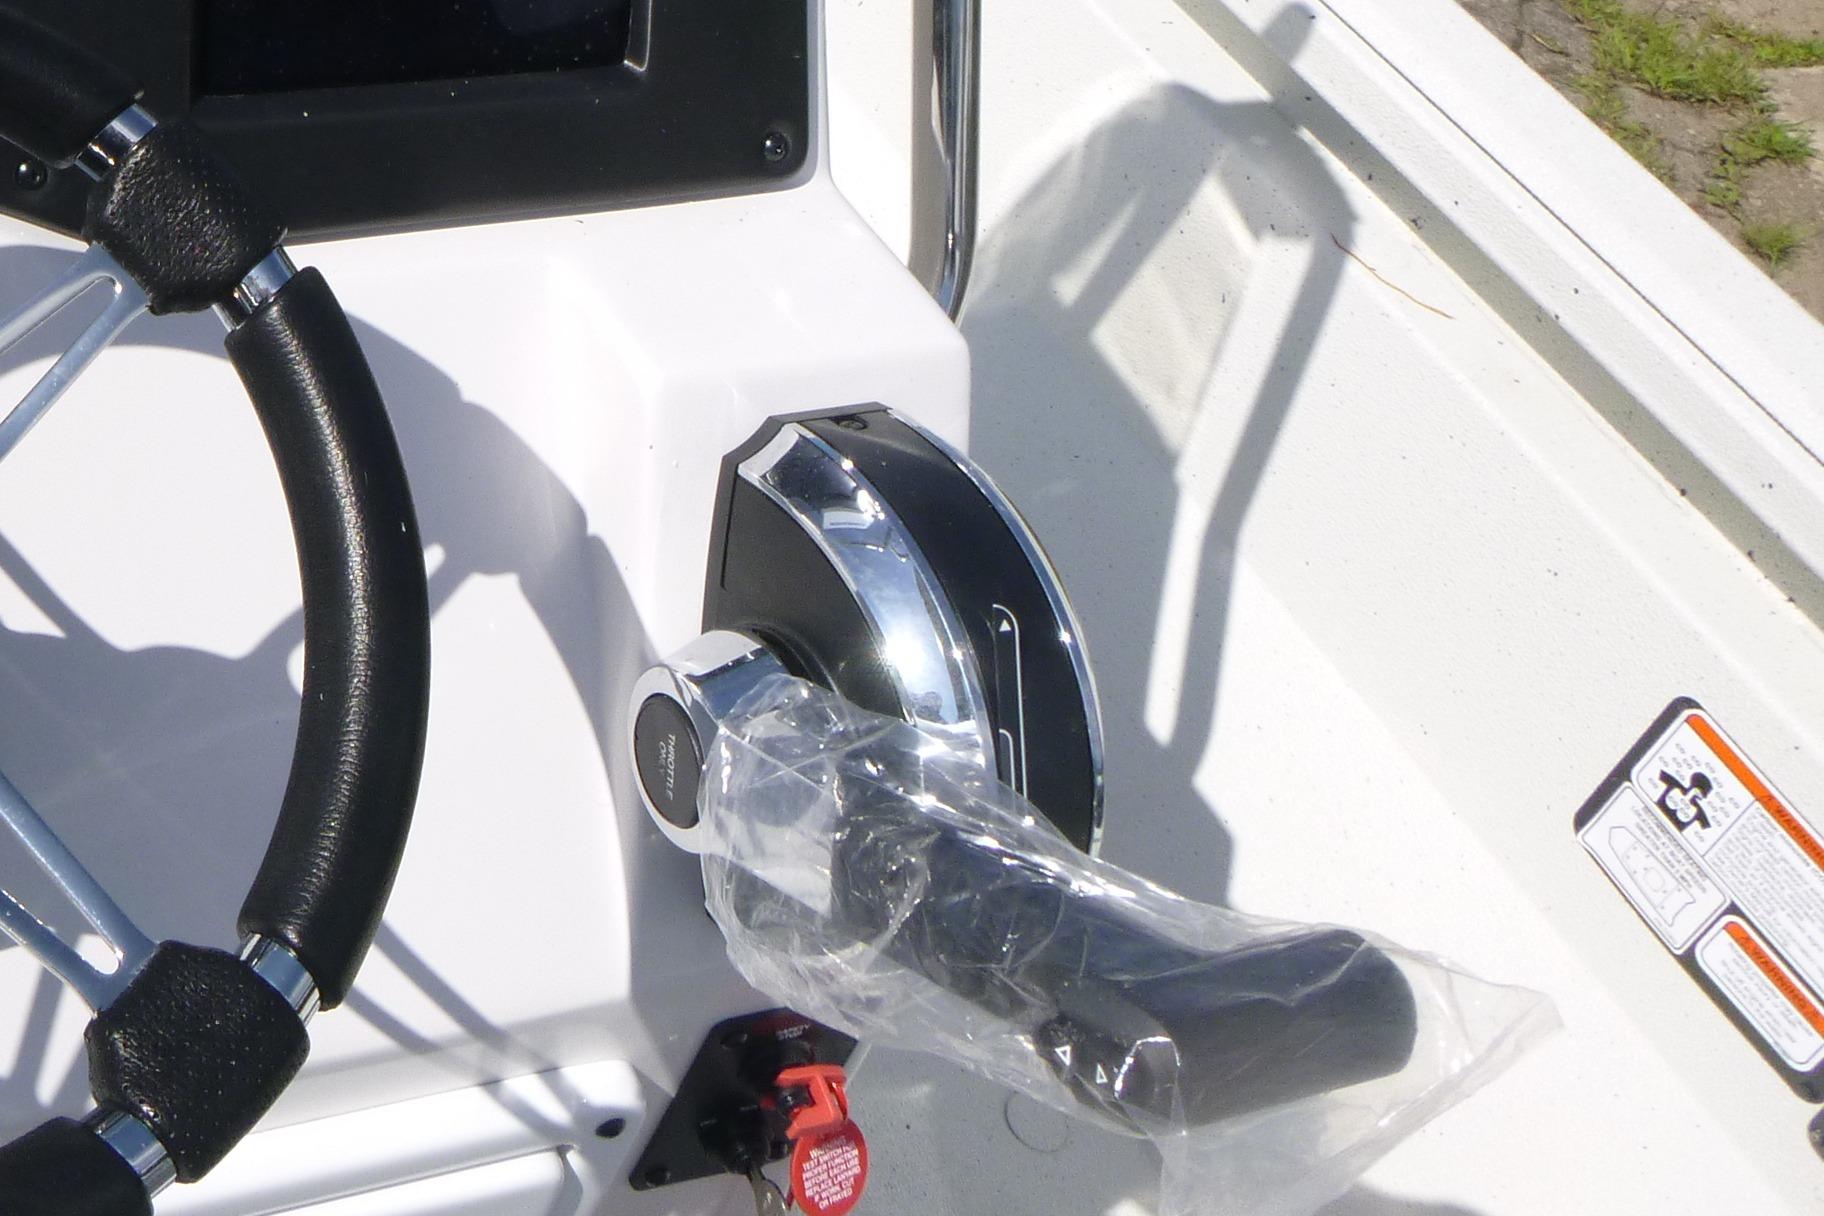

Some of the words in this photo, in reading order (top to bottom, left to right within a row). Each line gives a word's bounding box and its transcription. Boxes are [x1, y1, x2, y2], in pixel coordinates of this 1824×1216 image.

[801, 1157, 818, 1171] TEST
[818, 1146, 843, 1164] SWITCH
[801, 1162, 827, 1181] PROPER
[827, 1148, 859, 1169] FUNCTION
[803, 1172, 829, 1188] BEFORE
[828, 1162, 847, 1176] EACH
[846, 1156, 859, 1168] USE
[804, 1179, 832, 1198] REPLACE
